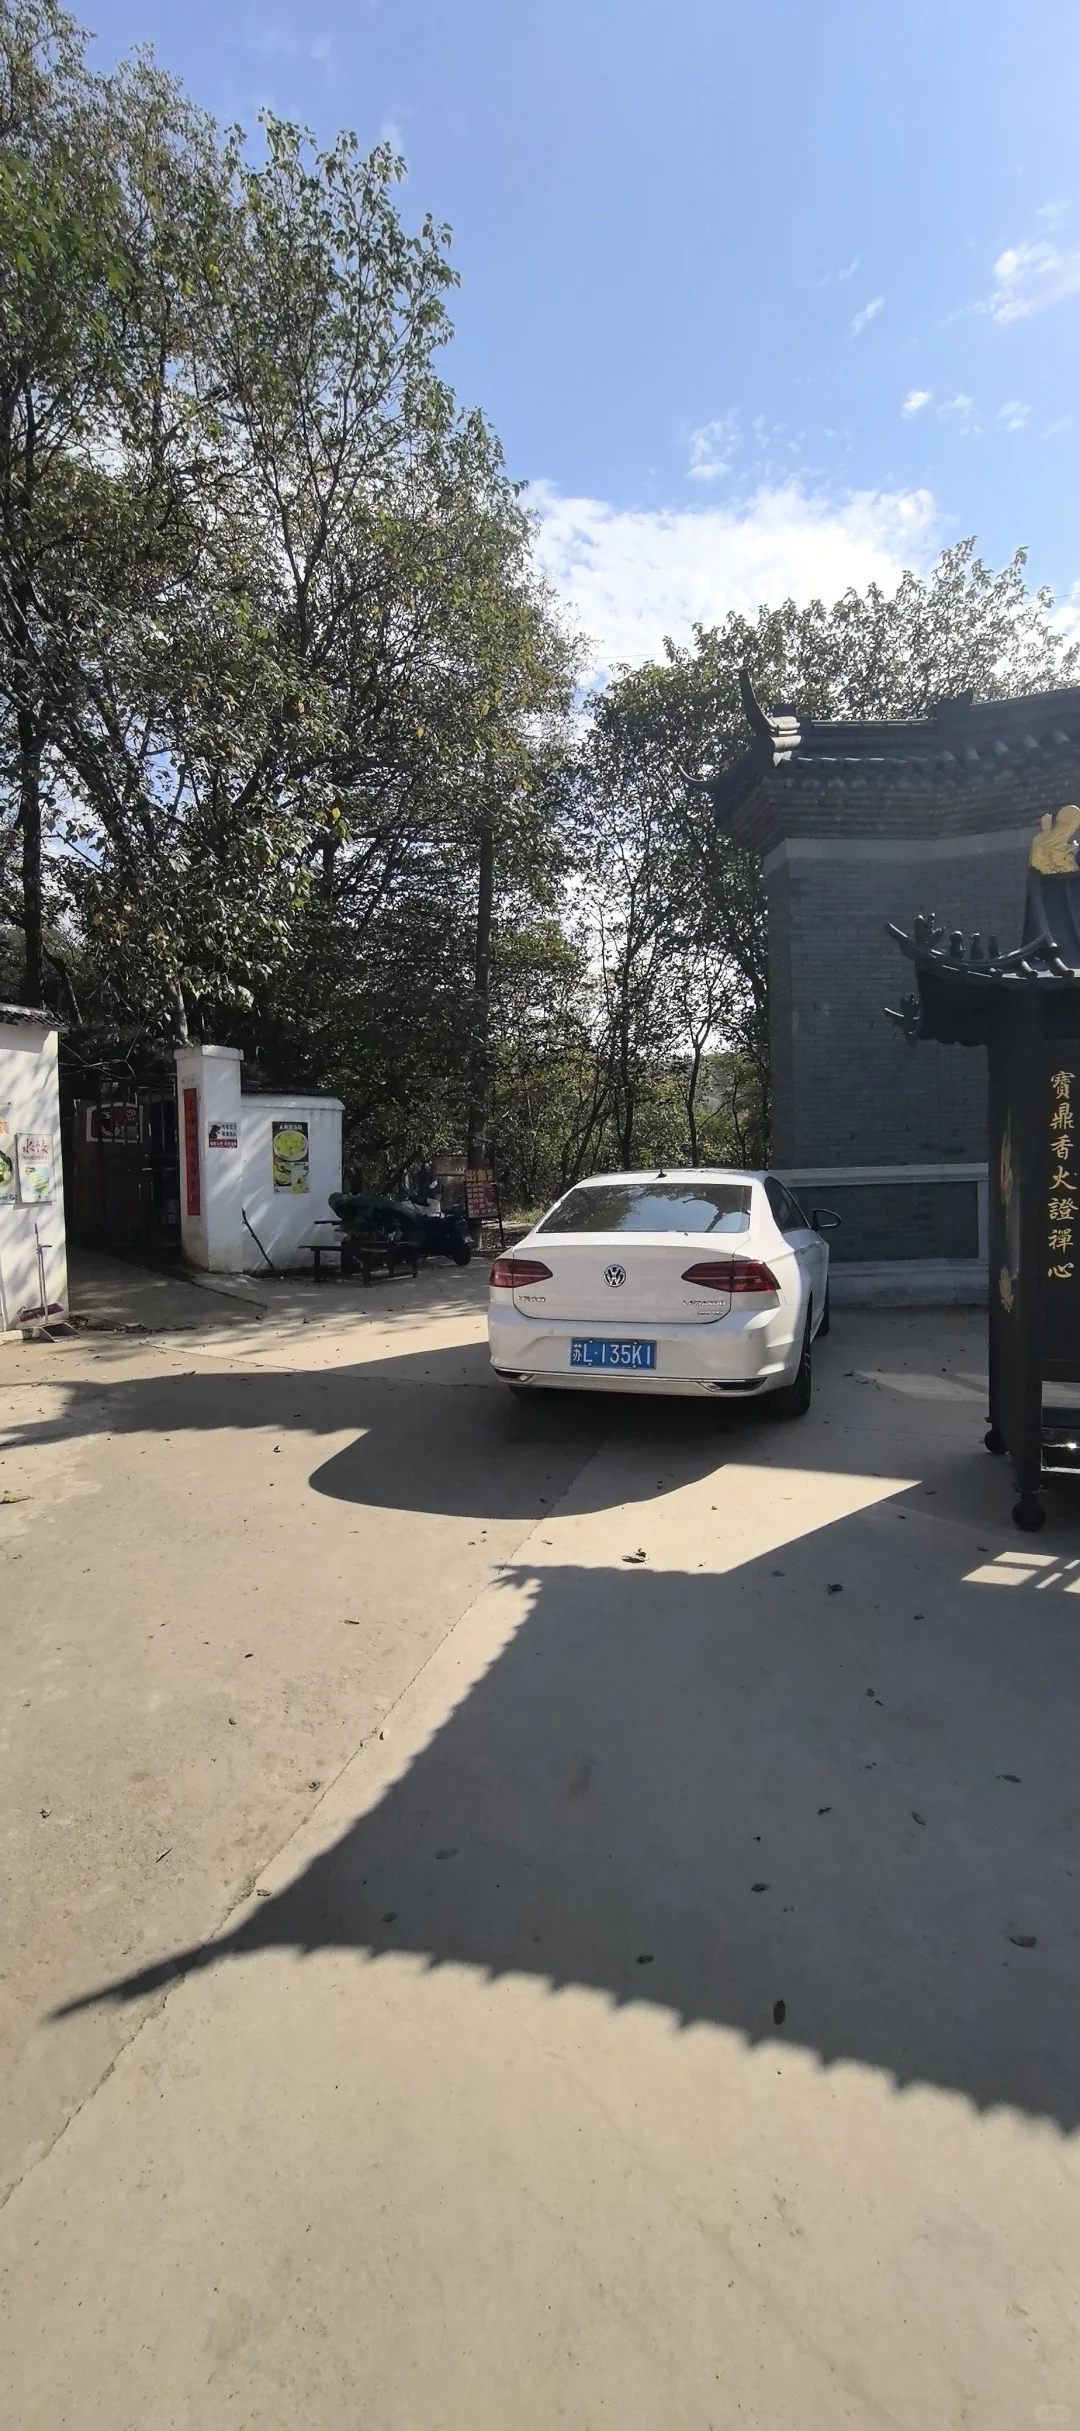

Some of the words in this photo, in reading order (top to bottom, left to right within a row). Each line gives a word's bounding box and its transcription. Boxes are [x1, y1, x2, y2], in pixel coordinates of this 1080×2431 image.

[22, 1138, 49, 1155] 水饺
[1048, 1071, 1079, 1279] 寶鼎香火證禪心
